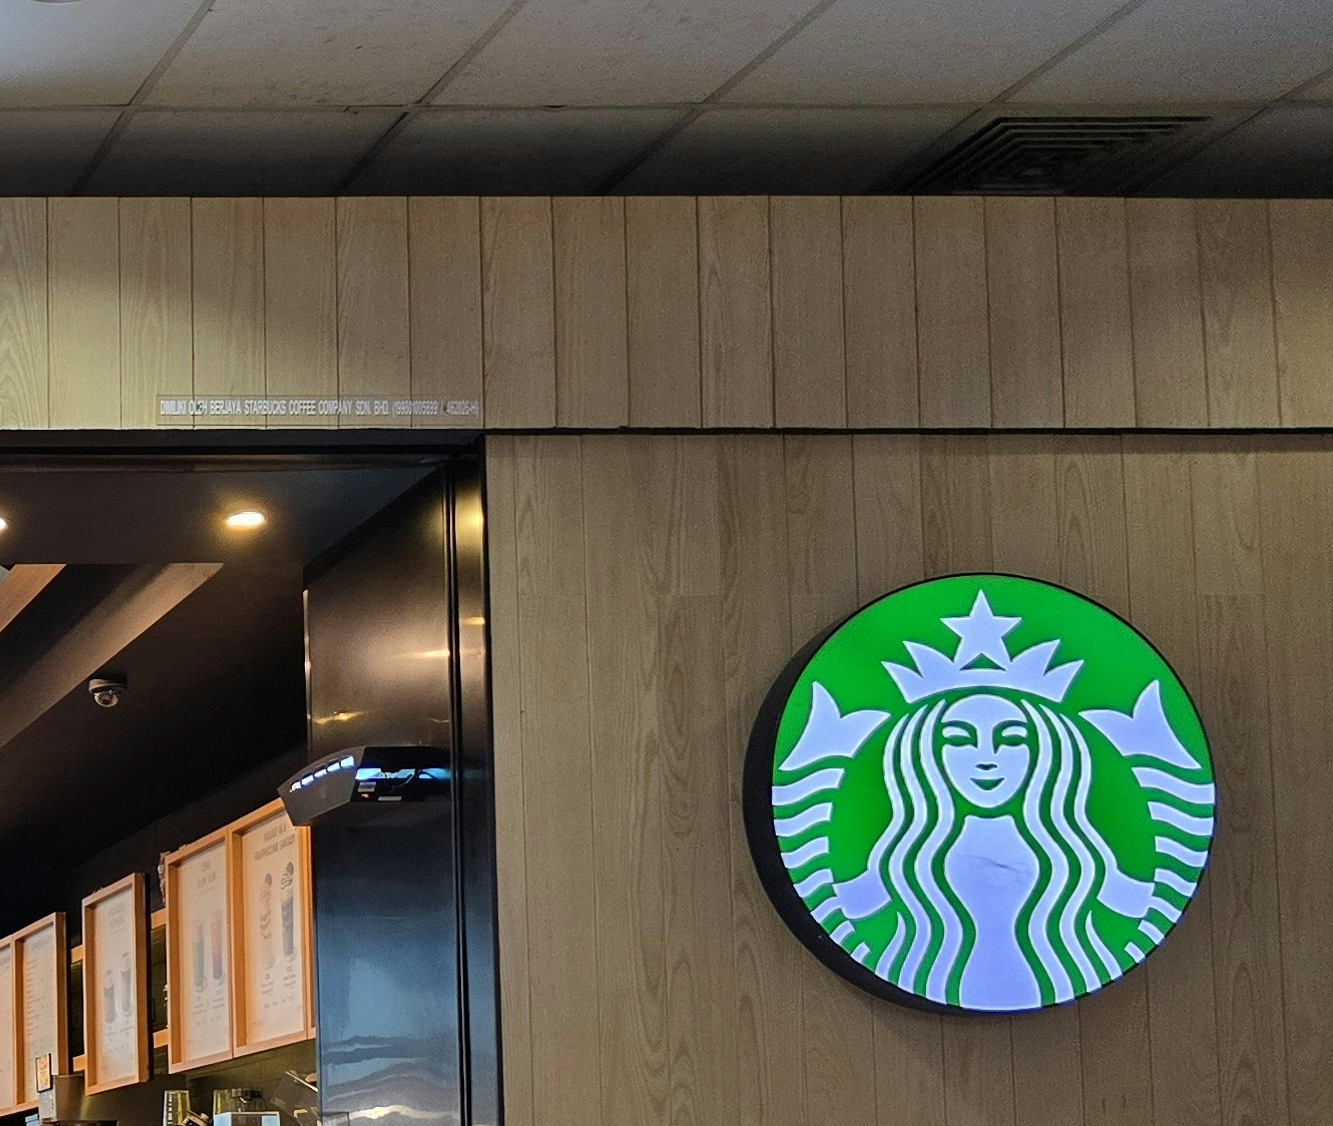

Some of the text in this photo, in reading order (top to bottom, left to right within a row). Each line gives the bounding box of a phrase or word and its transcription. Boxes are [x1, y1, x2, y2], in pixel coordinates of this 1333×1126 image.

[210, 400, 241, 415] BERJAYA
[244, 400, 286, 415] STARBUCKS
[289, 400, 316, 415] COFFEE
[318, 400, 352, 415] COMPANY
